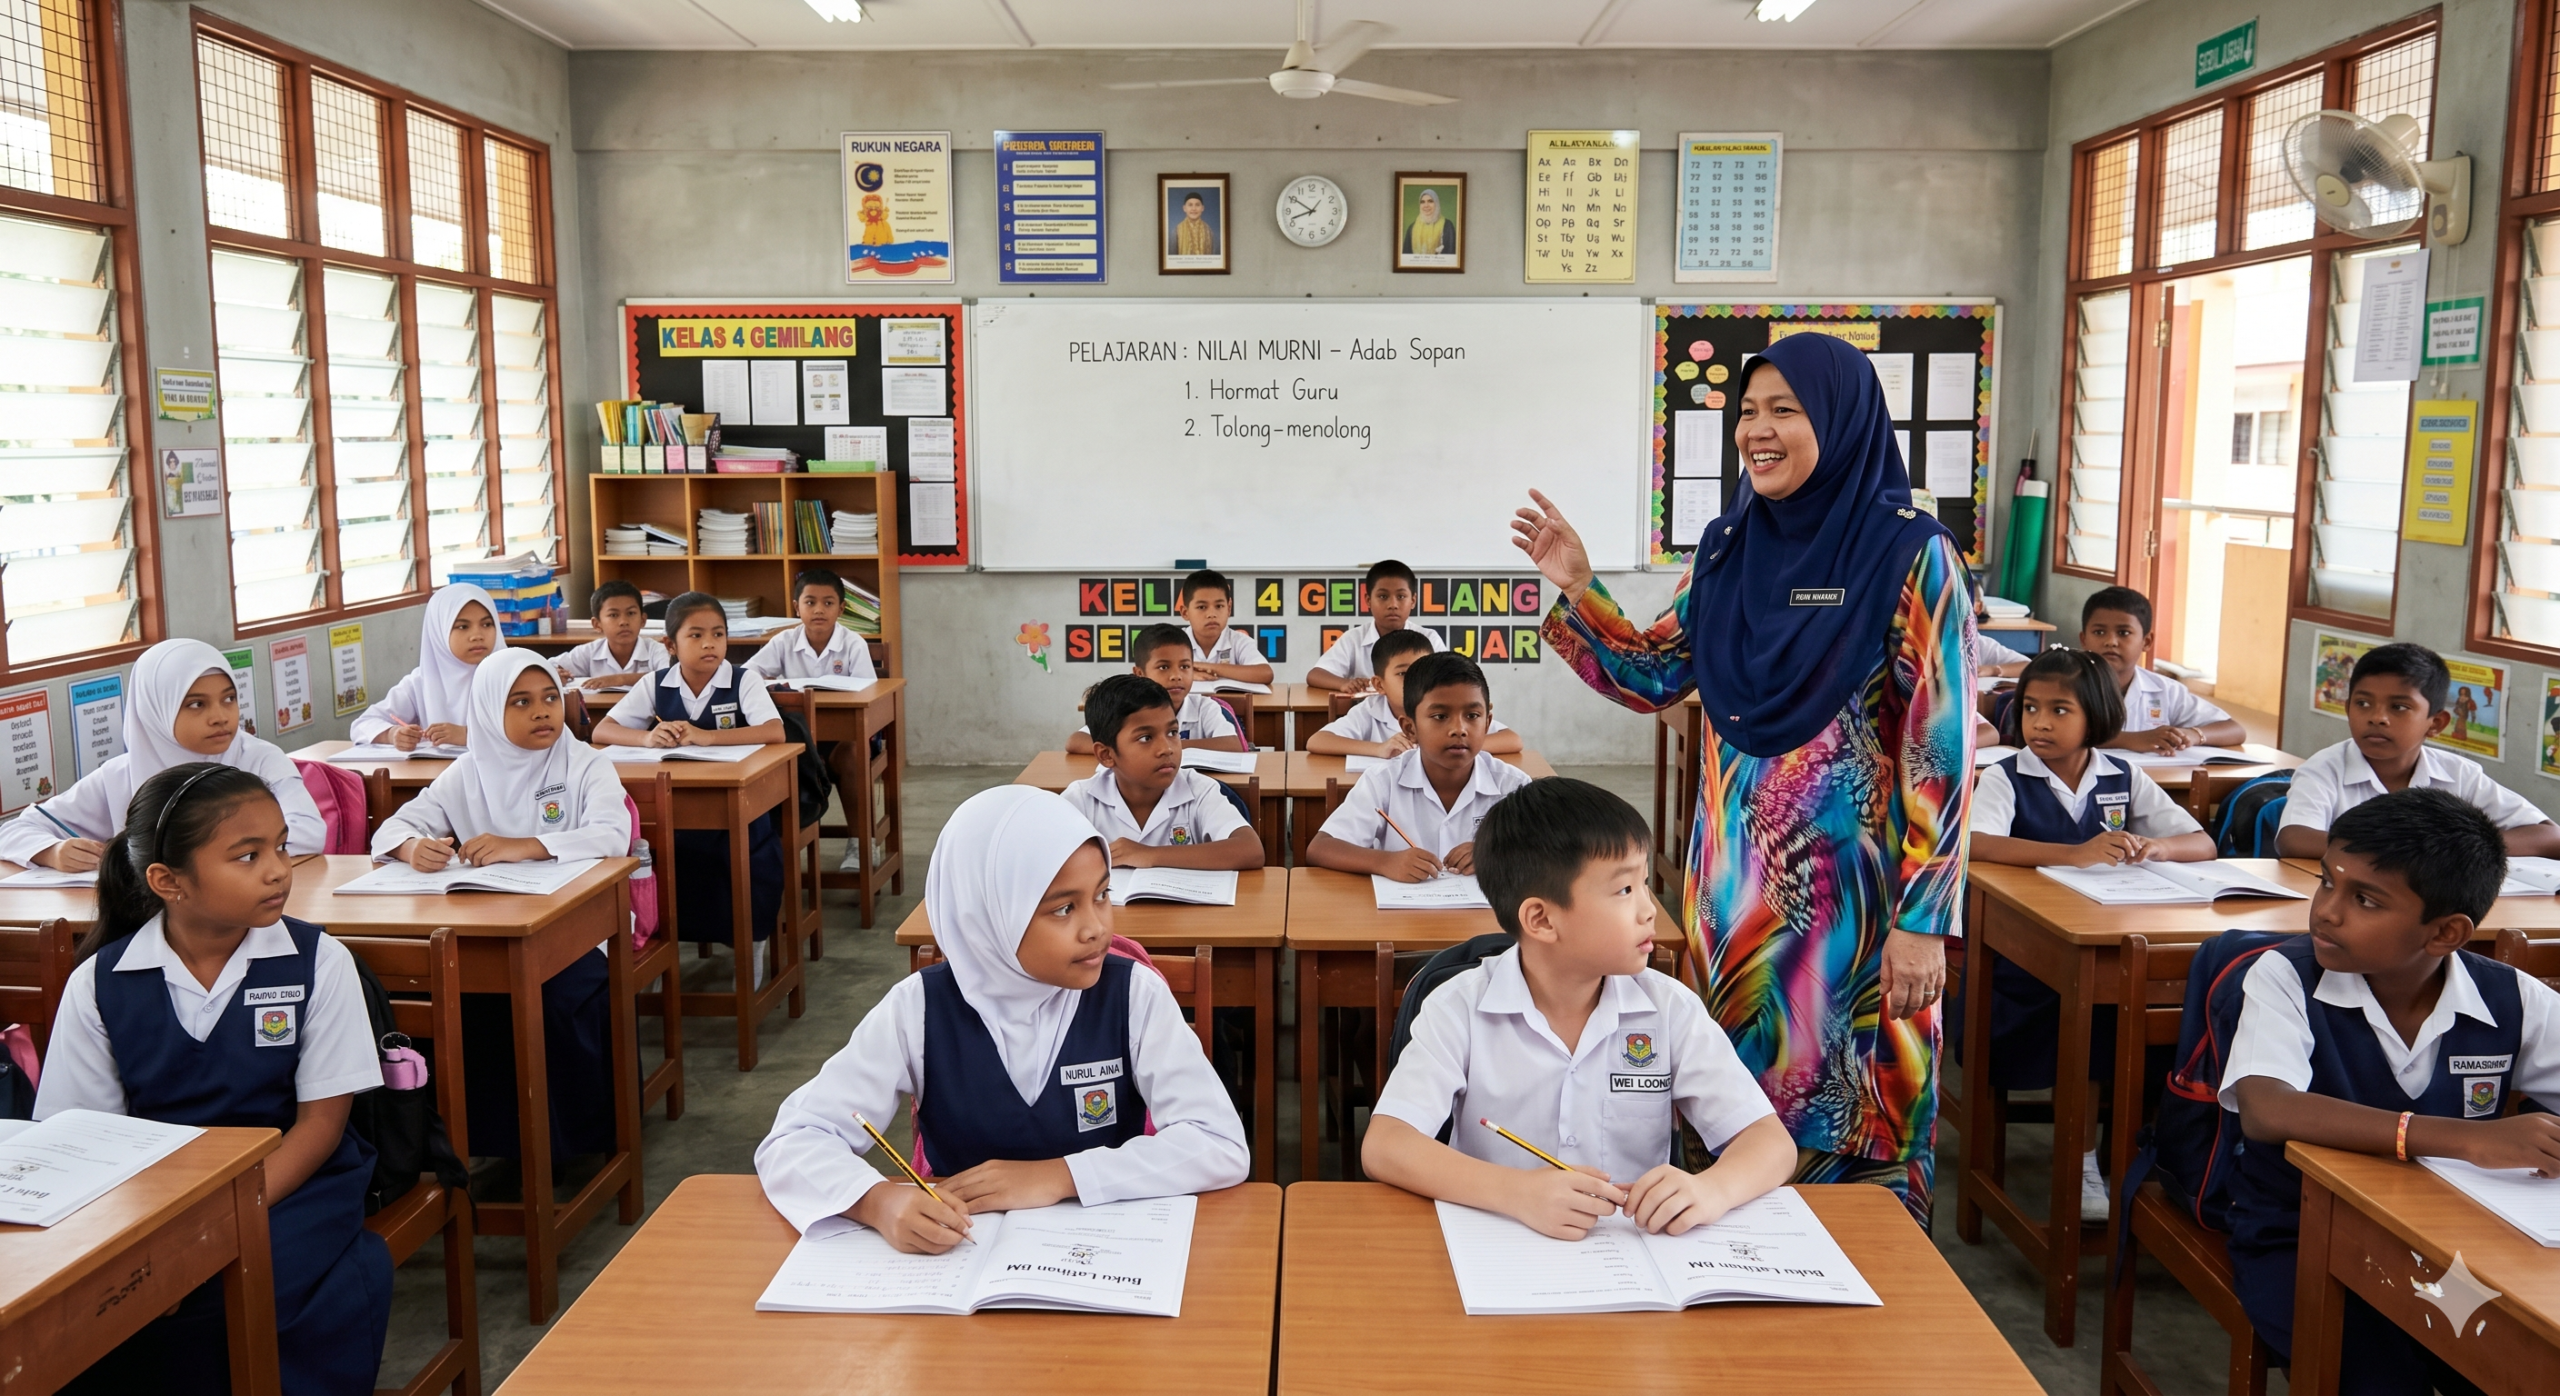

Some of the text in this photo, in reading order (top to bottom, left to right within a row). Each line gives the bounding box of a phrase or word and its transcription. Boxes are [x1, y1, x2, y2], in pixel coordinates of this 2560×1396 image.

[851, 141, 942, 152] RUKUN NEGARA
[1308, 184, 1316, 192] 12
[1328, 196, 1335, 204] 2
[1298, 228, 1304, 236] 7
[1309, 231, 1315, 239] 6
[1320, 227, 1326, 235] 5
[662, 326, 854, 349] KELAS 4 GEMILANG
[1197, 339, 1248, 361] NILAI
[1258, 339, 1322, 361] MURNI
[1349, 338, 1397, 361] Adab
[1409, 337, 1466, 367] Sopan
[1184, 377, 1339, 401] 1. Hormat Guru
[1184, 414, 1372, 450] 2. Tolong-menolong
[1080, 582, 1540, 613] KEL 4 GELANG
[1065, 1064, 1120, 1080] NURUL AINA
[1614, 1078, 1634, 1087] WEI
[1784, 1268, 1825, 1277] Buku
[1103, 1273, 1142, 1286] Buku
